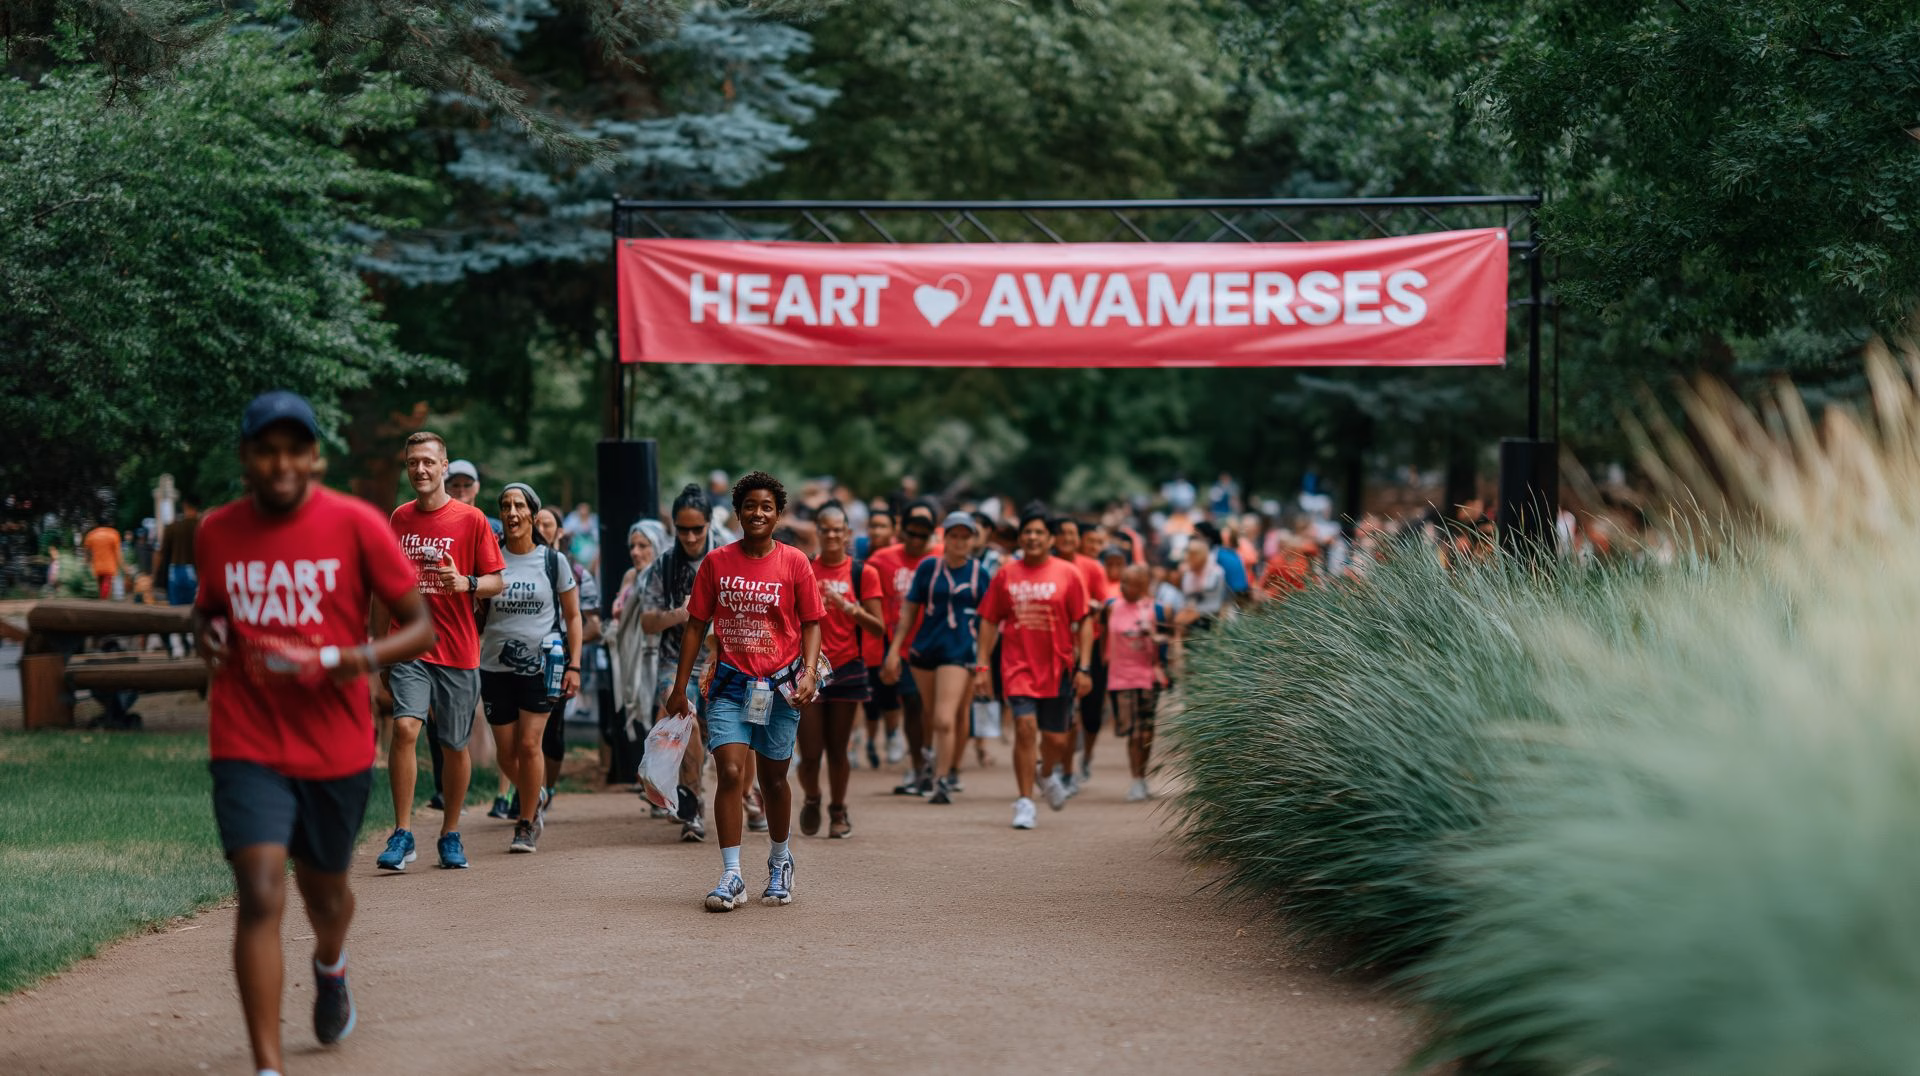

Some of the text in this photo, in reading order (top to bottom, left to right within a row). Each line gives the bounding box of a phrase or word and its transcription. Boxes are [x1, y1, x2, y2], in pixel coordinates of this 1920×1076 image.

[689, 270, 1428, 327] HEART AWAMERSES
[225, 559, 341, 592] HEART
